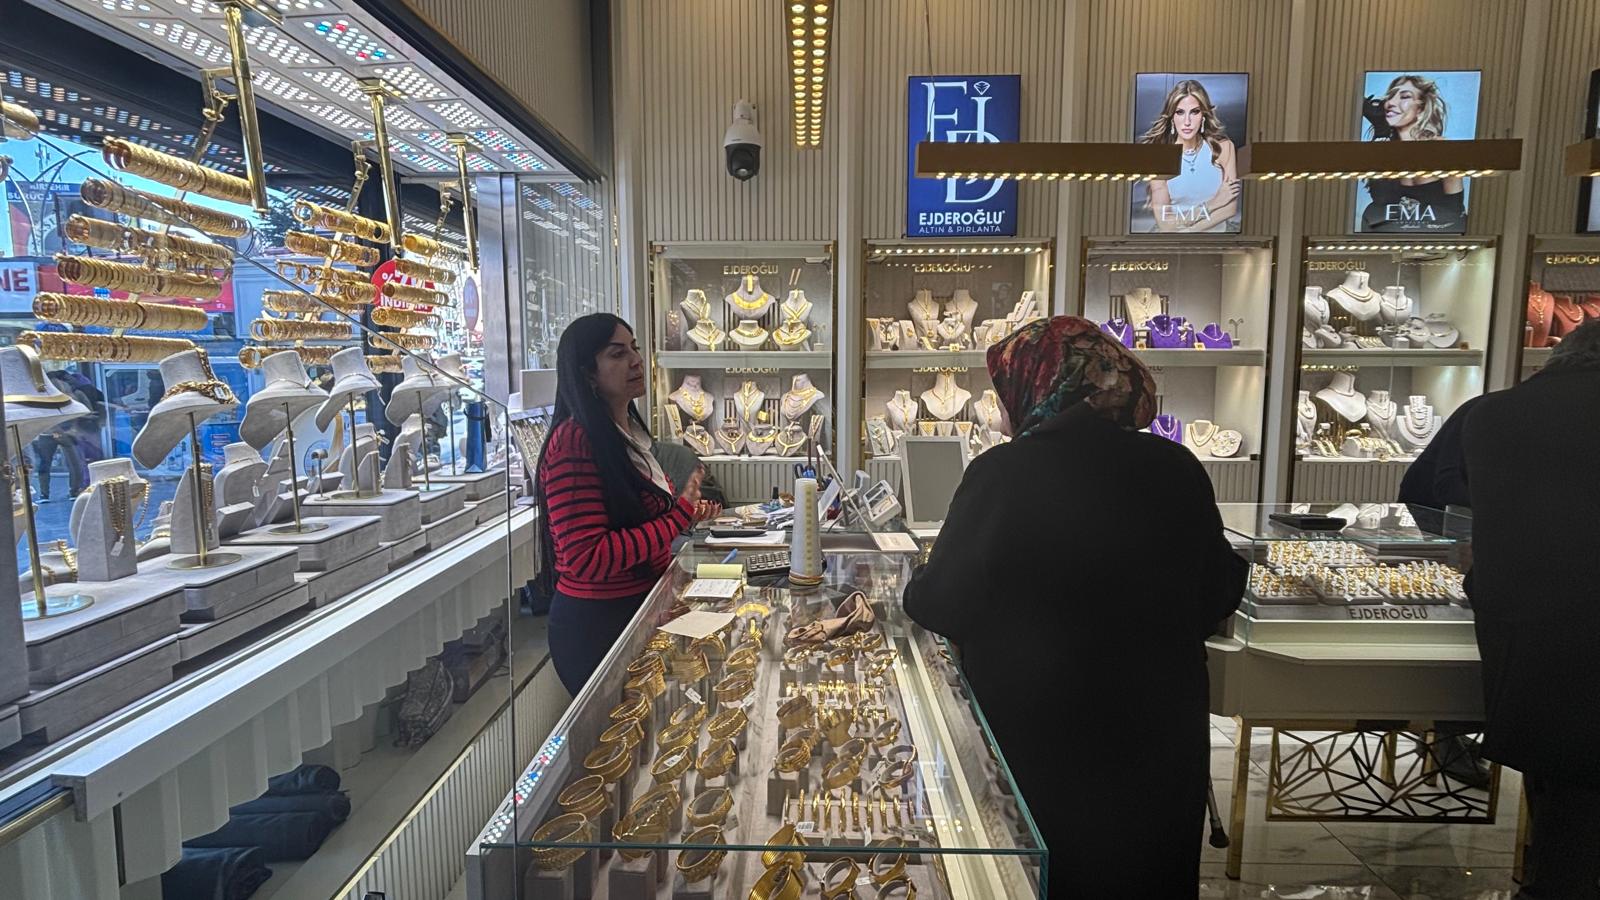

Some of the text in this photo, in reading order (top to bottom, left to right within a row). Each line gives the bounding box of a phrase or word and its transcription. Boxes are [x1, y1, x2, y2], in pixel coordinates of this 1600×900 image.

[919, 209, 1002, 226] EJDEROĞLU
[1161, 204, 1210, 221] EMA
[1385, 203, 1436, 221] EMA
[919, 226, 945, 234] ALTIN
[956, 225, 1001, 233] PIRLANTA
[1349, 606, 1428, 620] EJDEROĞLU
